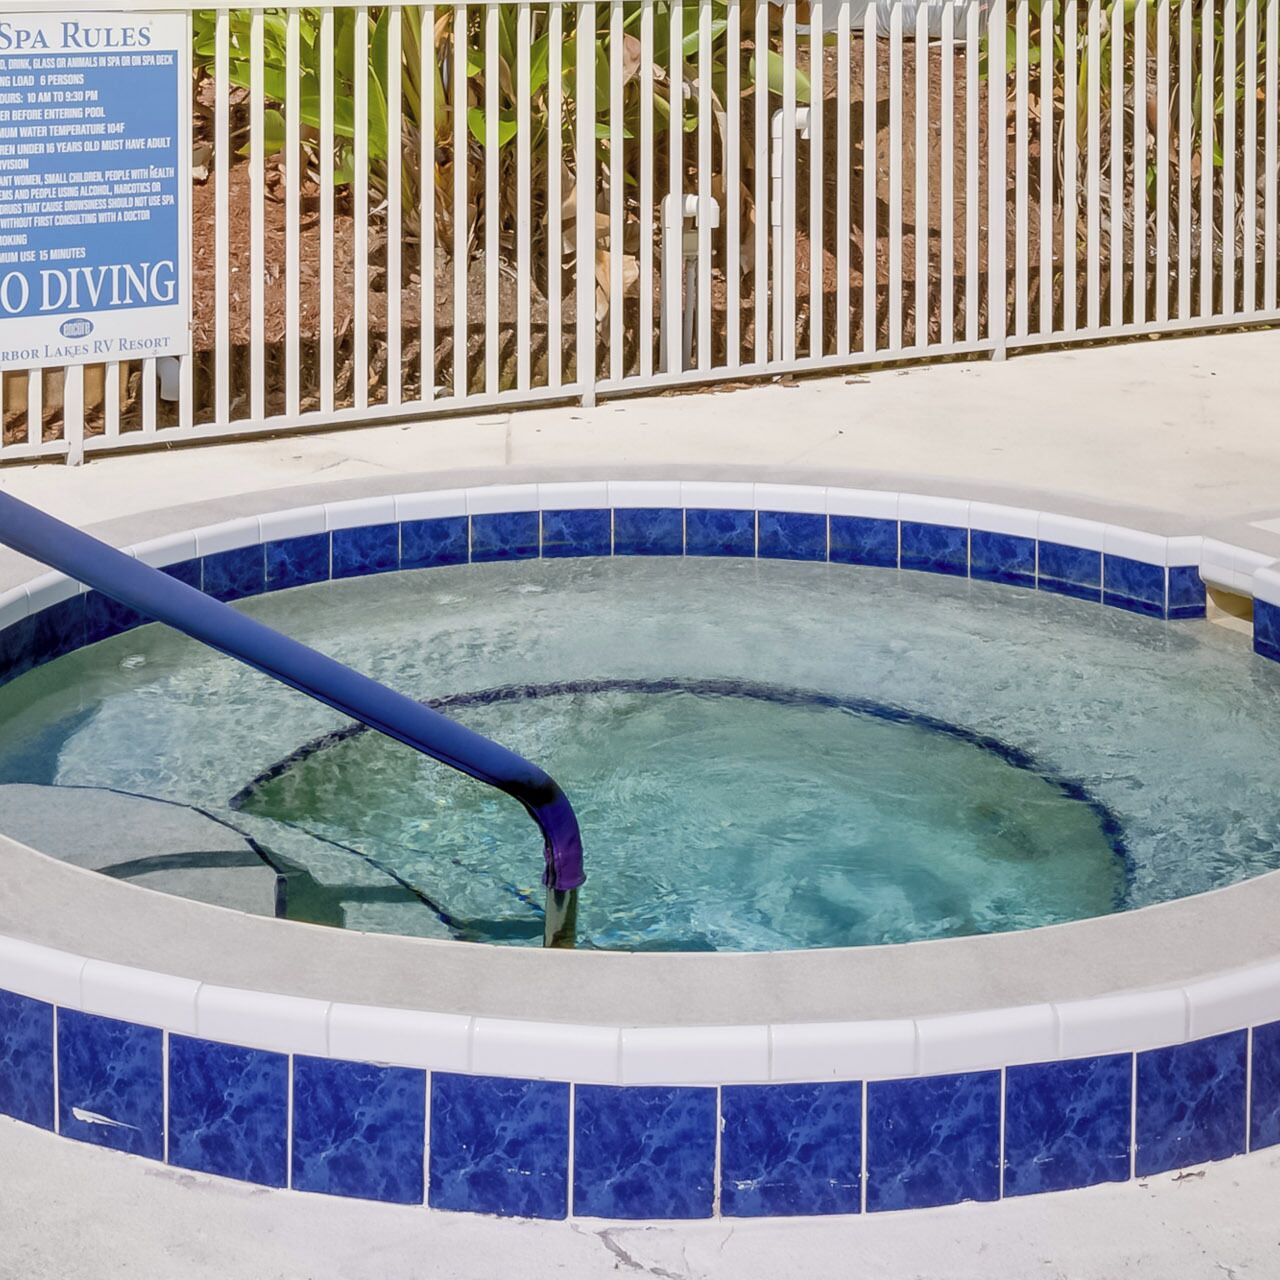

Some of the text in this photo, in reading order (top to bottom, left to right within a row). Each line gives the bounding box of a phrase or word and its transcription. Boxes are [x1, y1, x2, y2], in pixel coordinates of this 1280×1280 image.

[33, 57, 55, 69] GLASS
[56, 57, 67, 68] OR
[99, 56, 107, 67] IN
[107, 56, 120, 67] SPA
[121, 55, 130, 66] OR
[132, 55, 141, 66] ON
[142, 54, 155, 66] SPA
[156, 54, 173, 65] DECK
[12, 75, 34, 86] LOAD
[40, 75, 46, 86] 6
[48, 74, 84, 85] PERSONS
[27, 92, 36, 103] 10
[38, 92, 51, 103] AM
[52, 91, 63, 102] TO
[65, 91, 83, 102] 9:30
[85, 90, 98, 101] PM
[12, 109, 43, 121] BEFORE
[44, 108, 83, 120] ENTERING
[85, 107, 106, 118] POOL
[19, 126, 48, 137] WATER
[48, 123, 106, 136] TEMPERATURE
[107, 122, 125, 134] 104F
[17, 143, 44, 155] UNDER
[46, 143, 54, 153] 16
[56, 141, 82, 152] YEARS
[84, 140, 99, 152] OLD
[101, 139, 123, 151] MUST
[125, 138, 146, 149] HAVE
[146, 137, 171, 149] ADULT
[44, 173, 68, 184] SMALL
[105, 169, 130, 181] PEOPLE
[131, 168, 148, 179] WITH
[150, 167, 174, 178] HEALTH
[14, 189, 29, 200] AND
[30, 188, 56, 199] PEOPLE
[58, 186, 78, 197] USING
[151, 182, 161, 193] OR
[23, 202, 40, 213] THAT
[41, 201, 63, 212] CAUSE
[108, 197, 133, 208] SHOULD
[134, 196, 147, 207] NOT
[148, 195, 161, 206] USE
[161, 194, 175, 205] SPA
[0, 217, 32, 229] WITHOUT
[34, 216, 54, 227] FIRST
[55, 213, 96, 225] CONSULTING
[98, 212, 116, 223] WITH
[117, 211, 123, 222] A
[124, 210, 150, 221] DOCTOR
[20, 250, 36, 262] USE
[40, 250, 48, 261] 15
[50, 247, 86, 260] MINUTES
[40, 260, 176, 311] DIVING
[94, 340, 114, 354] RV
